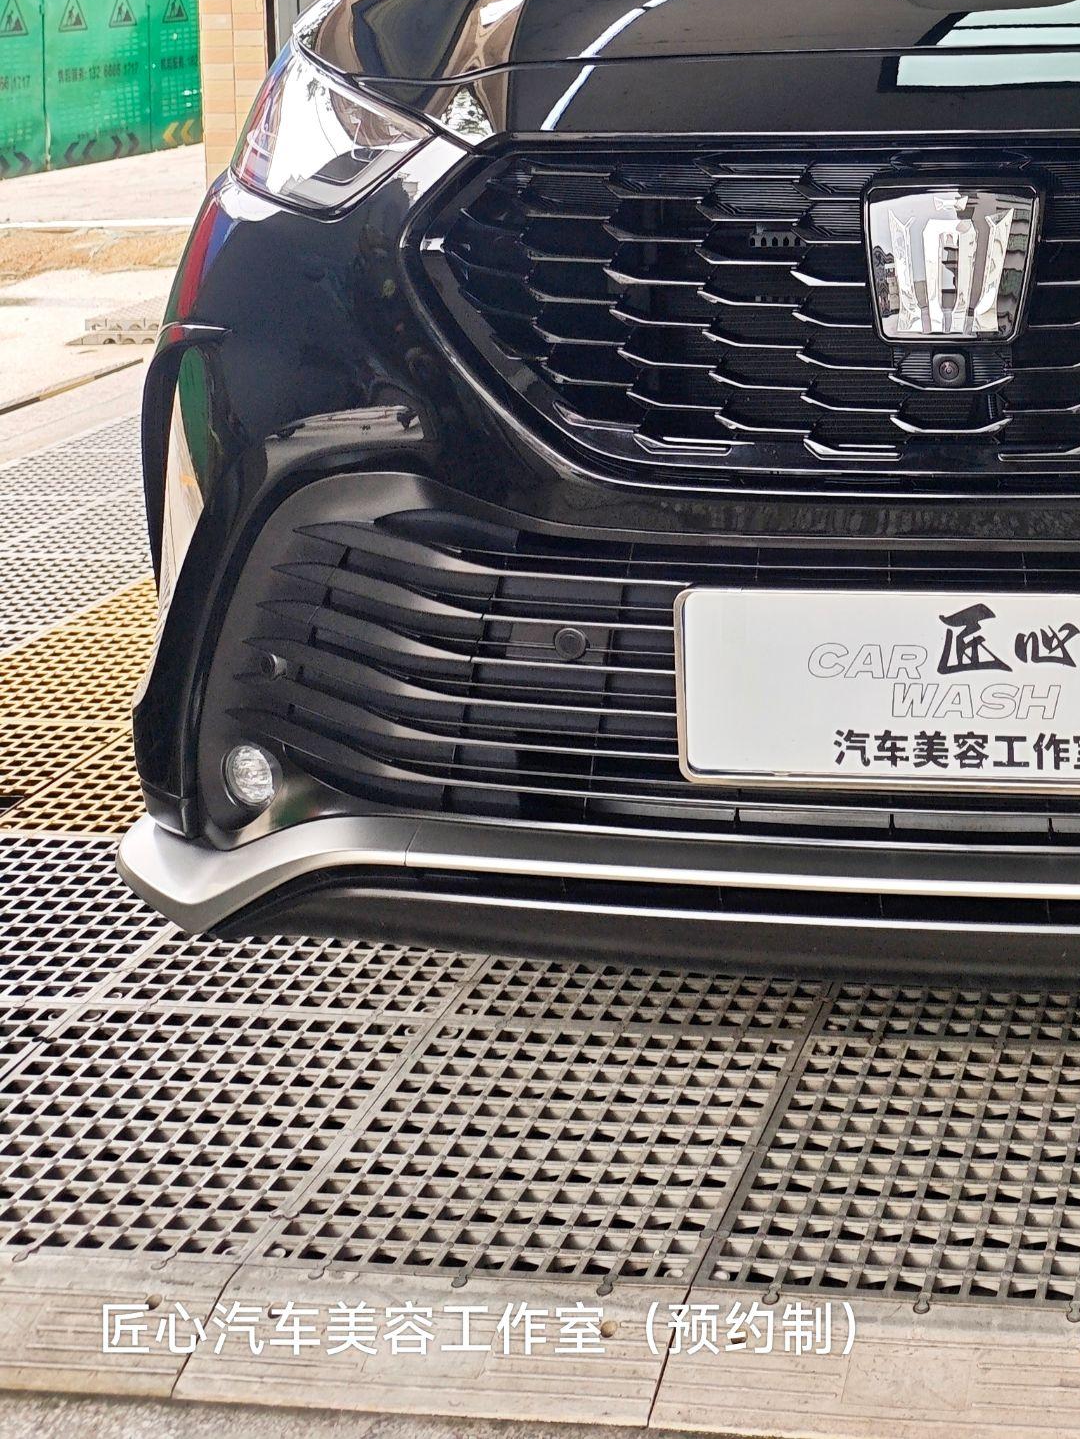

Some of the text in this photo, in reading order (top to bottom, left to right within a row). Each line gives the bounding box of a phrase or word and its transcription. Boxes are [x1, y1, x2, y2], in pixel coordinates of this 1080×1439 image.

[937, 603, 1080, 675] 匠心
[807, 642, 928, 680] CAR
[891, 682, 1062, 720] WASH
